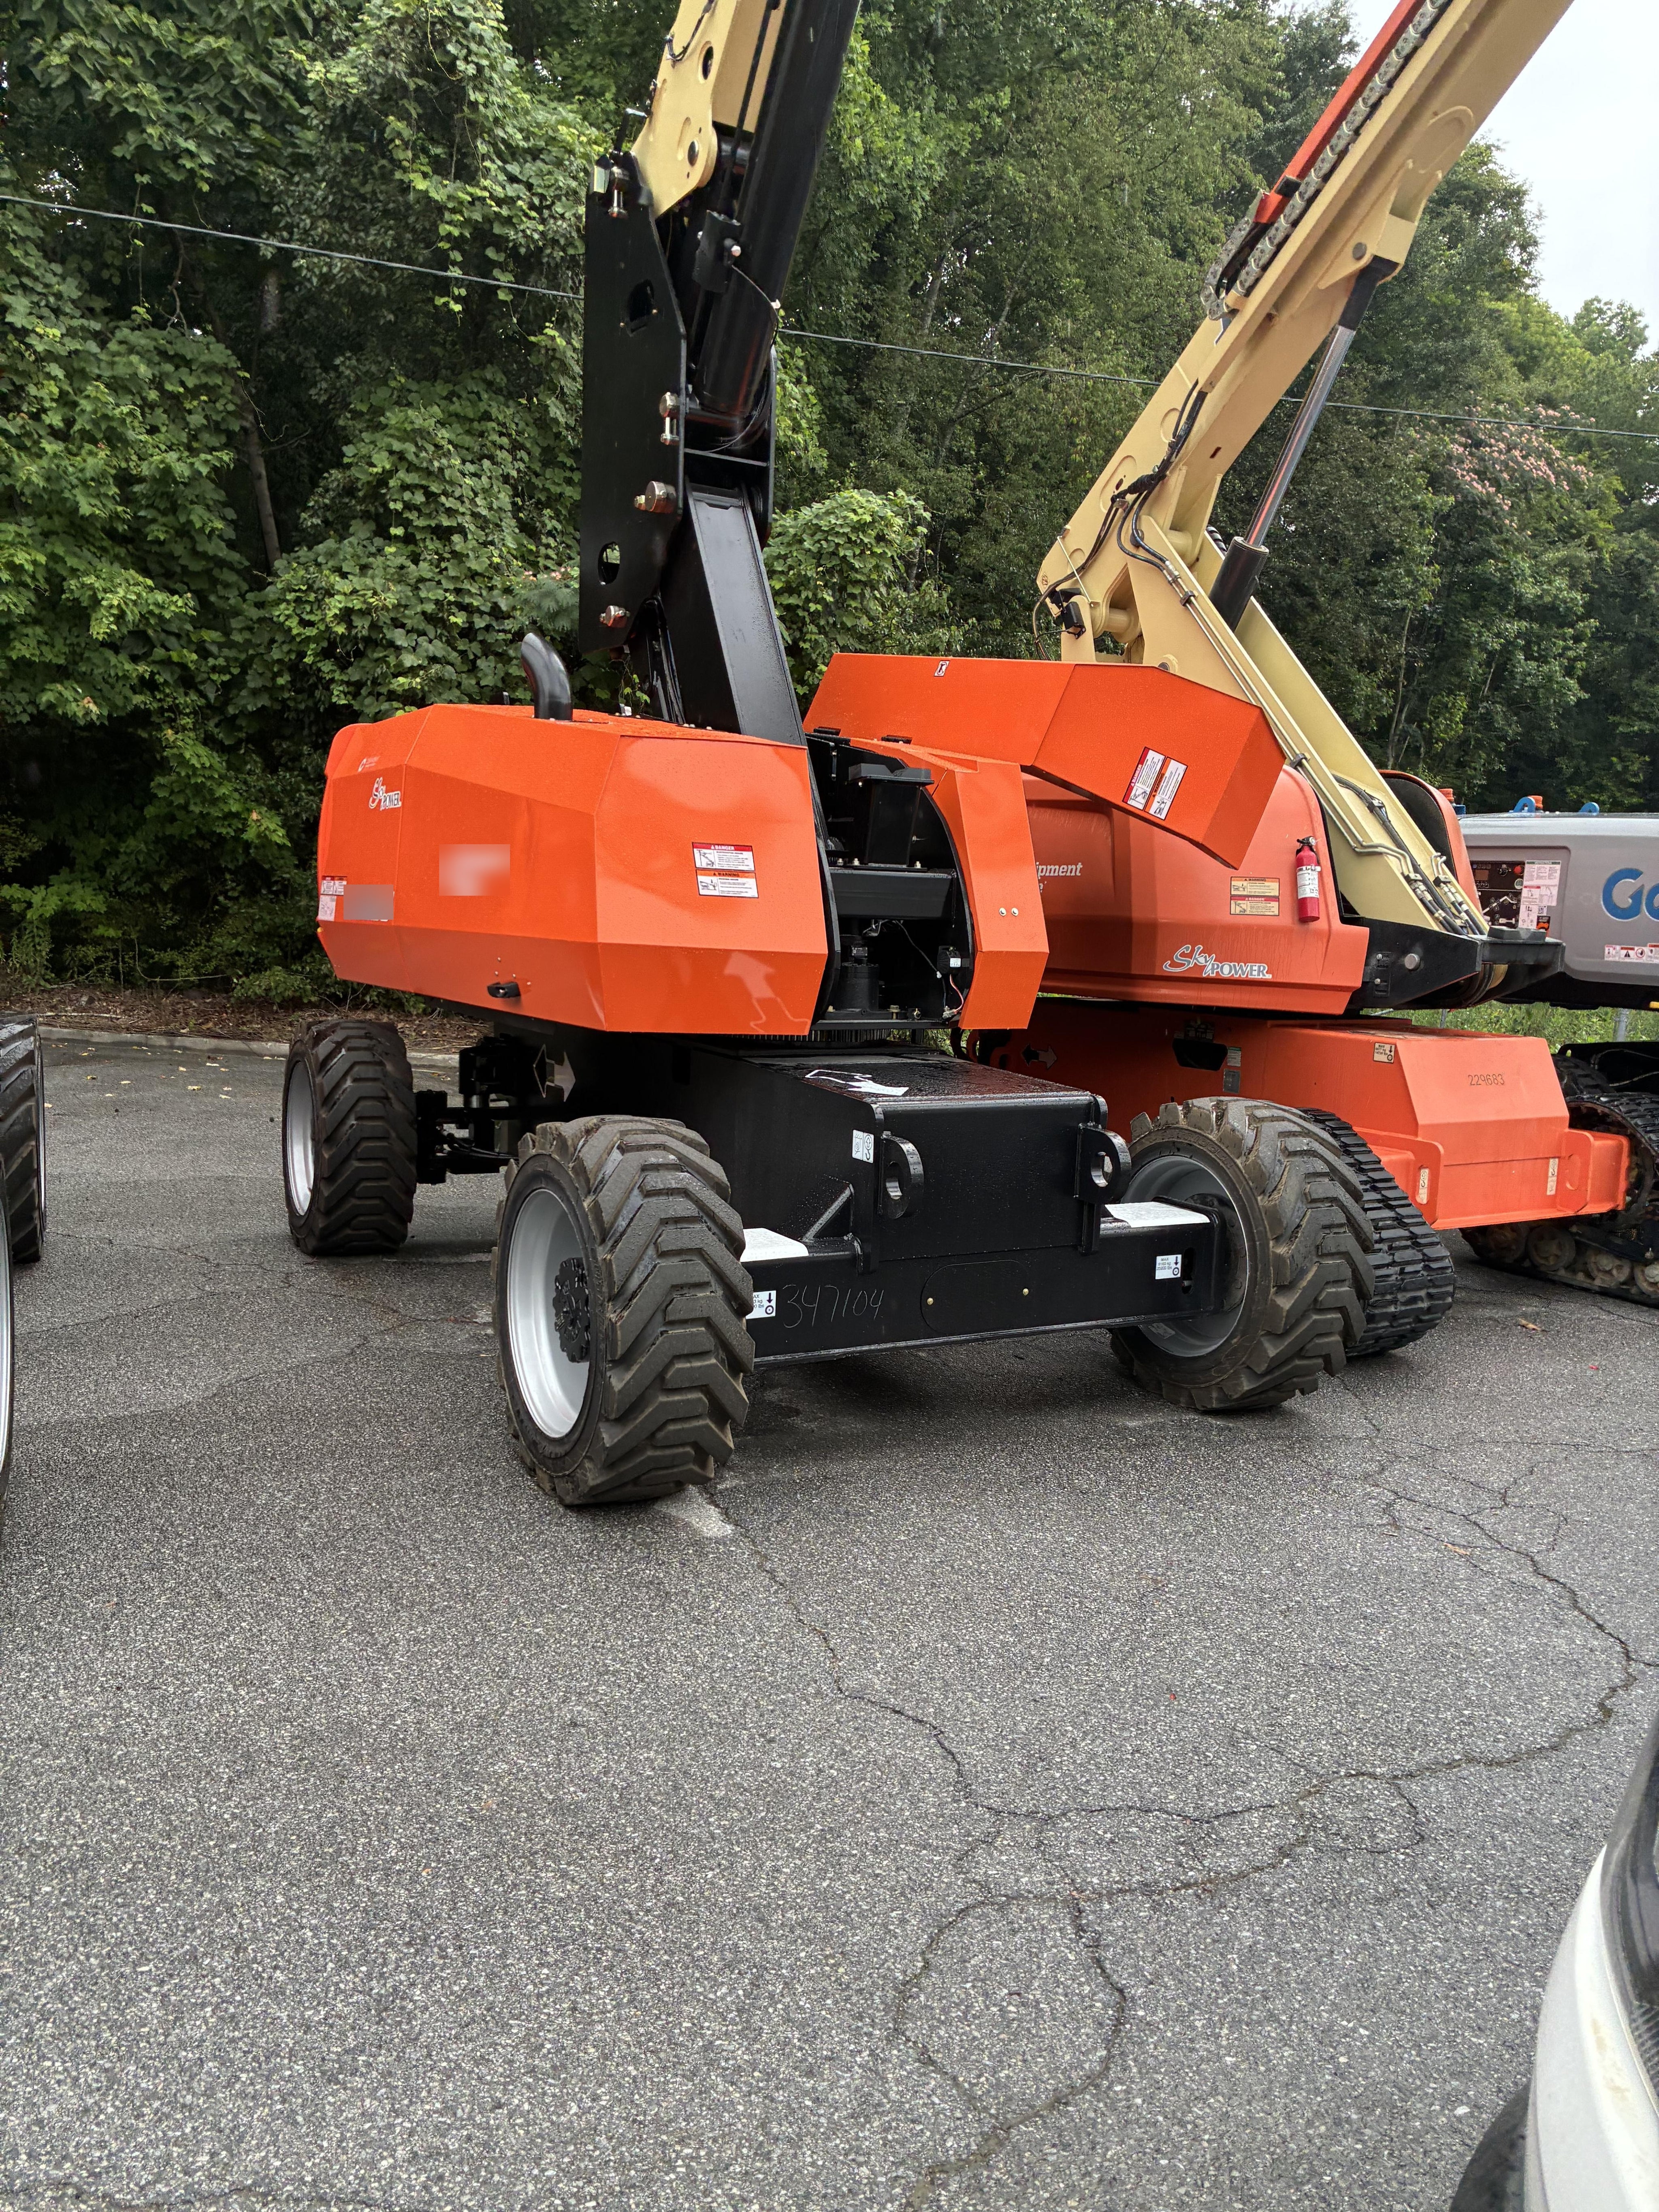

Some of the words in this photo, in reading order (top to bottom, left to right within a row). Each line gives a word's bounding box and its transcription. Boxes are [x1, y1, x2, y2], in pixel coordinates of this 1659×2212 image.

[1163, 945, 1215, 977] Sky
[1209, 962, 1269, 978] POWER
[1468, 1073, 1505, 1086] 229683
[782, 1284, 884, 1328] 347104
